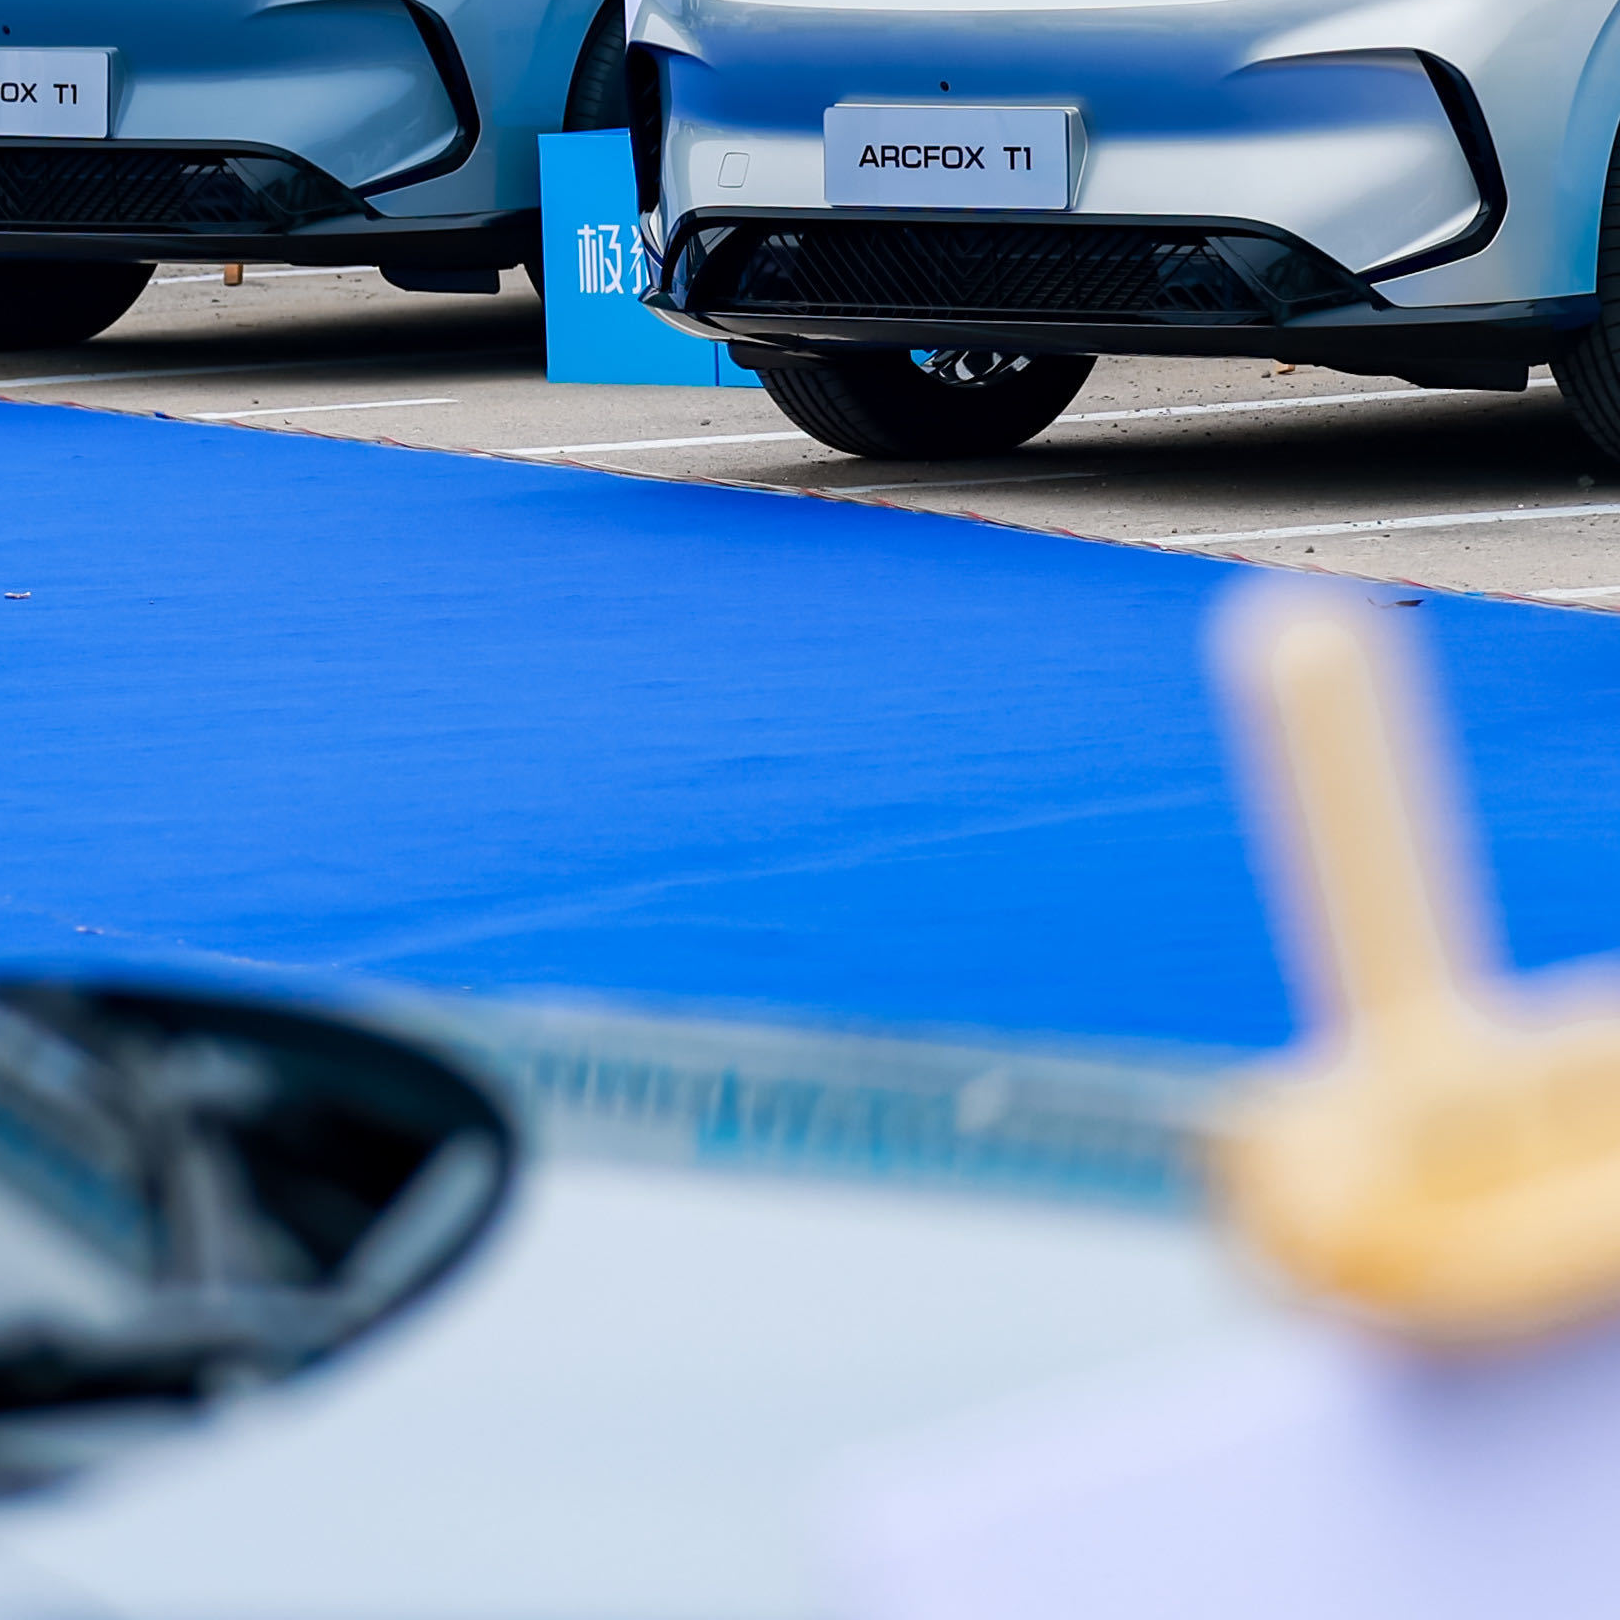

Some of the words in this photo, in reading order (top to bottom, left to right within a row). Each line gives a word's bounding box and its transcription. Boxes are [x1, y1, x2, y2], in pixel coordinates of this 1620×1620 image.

[53, 83, 78, 105] T1
[858, 144, 985, 170] ARCFOX
[1003, 146, 1032, 171] T1
